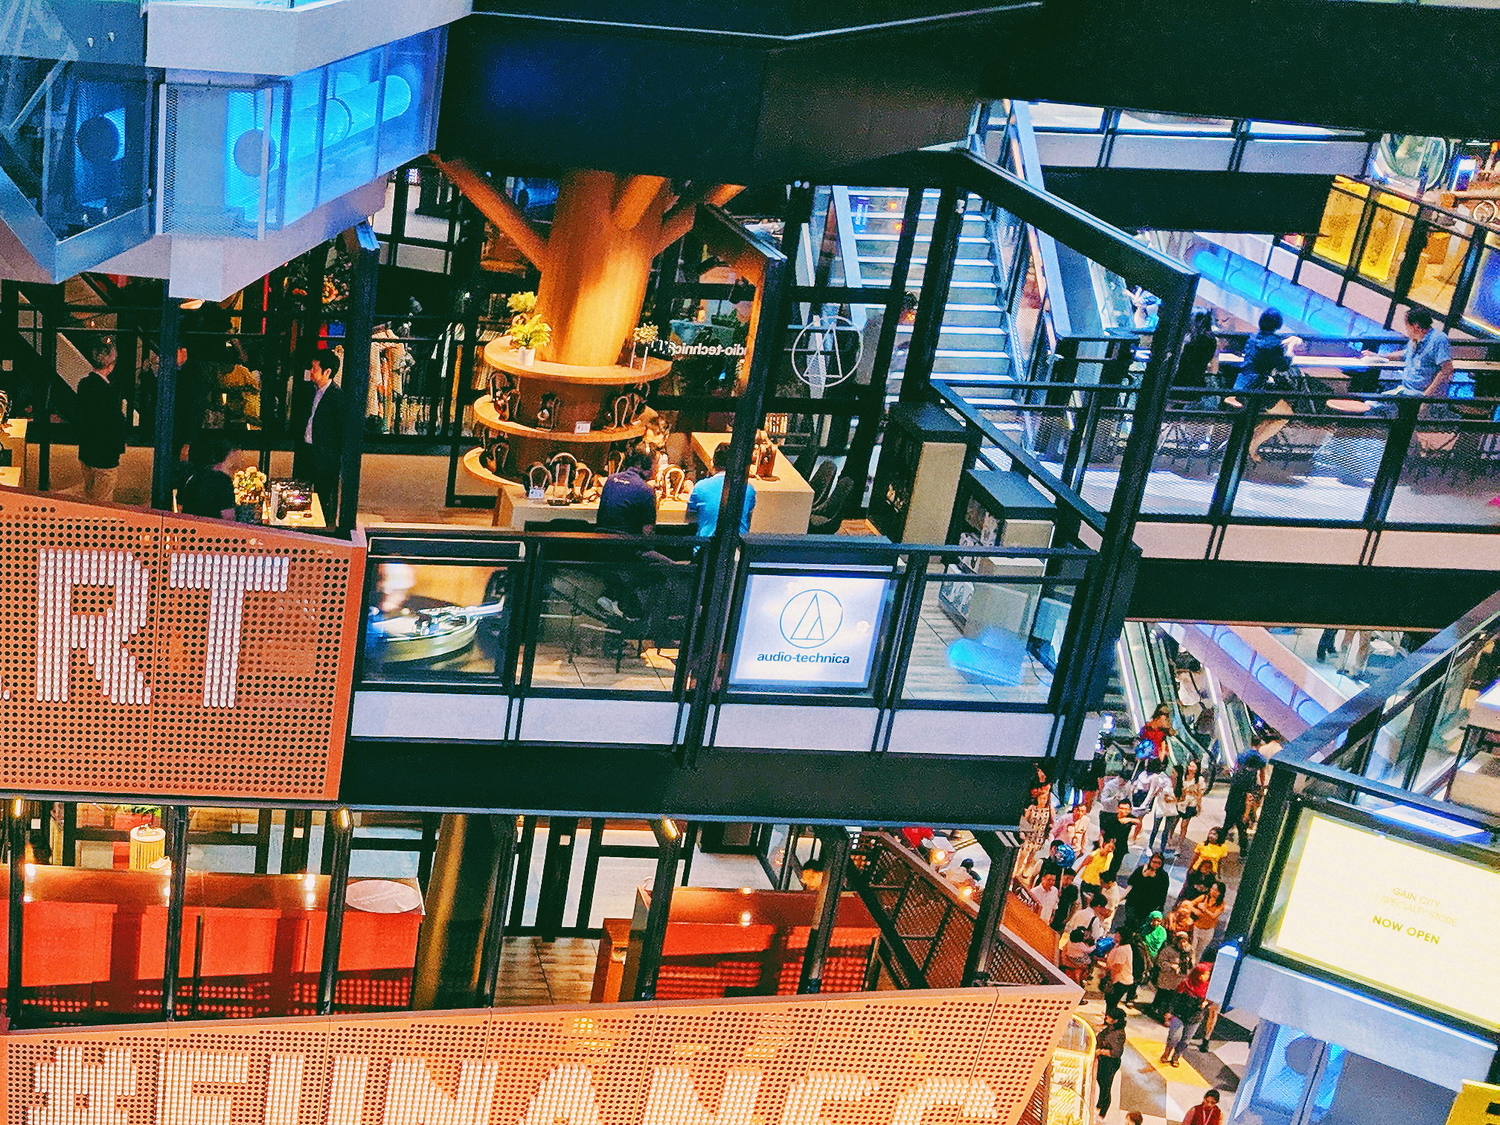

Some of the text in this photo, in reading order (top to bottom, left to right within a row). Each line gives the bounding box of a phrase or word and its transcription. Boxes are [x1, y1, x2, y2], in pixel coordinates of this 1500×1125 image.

[756, 651, 850, 664] audio-technica
[1392, 887, 1441, 908] GAIN CITY
[1381, 895, 1426, 915] SPECIALTY
[1428, 909, 1458, 927] STORE
[1372, 914, 1441, 945] NOW OPEN
